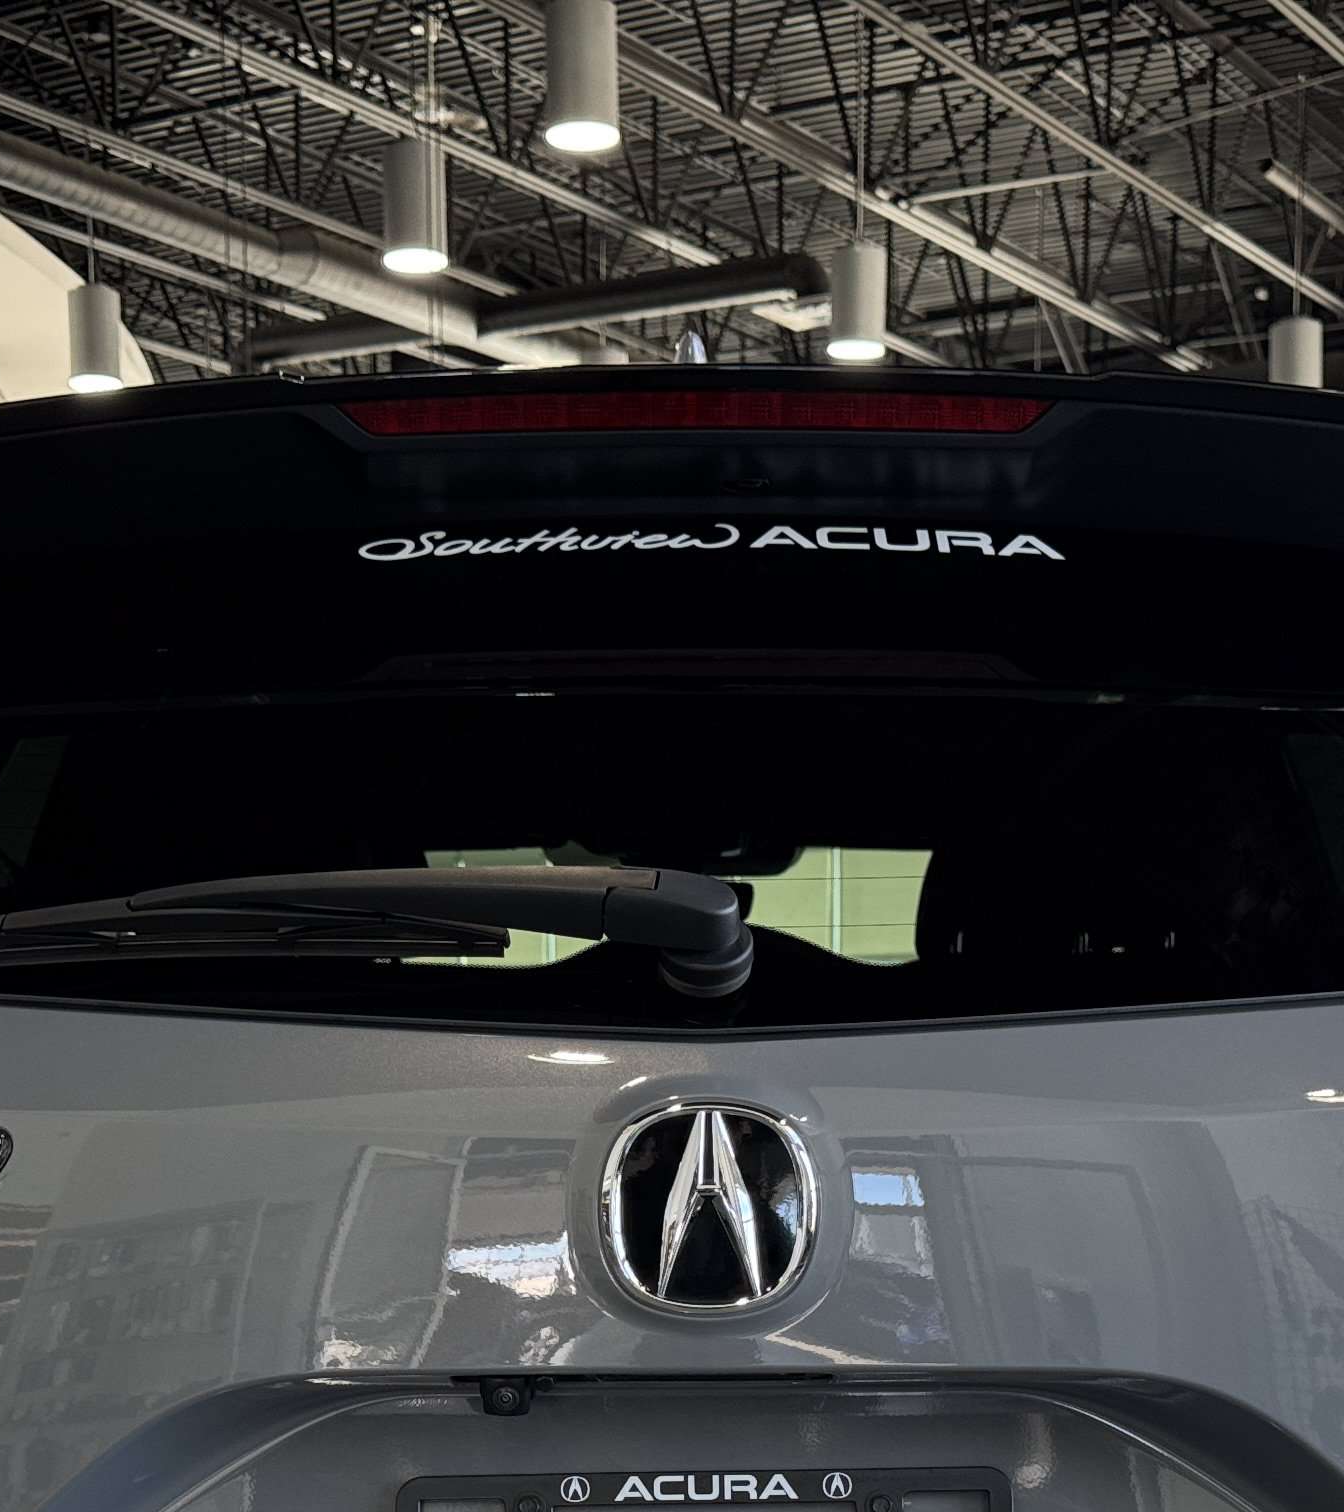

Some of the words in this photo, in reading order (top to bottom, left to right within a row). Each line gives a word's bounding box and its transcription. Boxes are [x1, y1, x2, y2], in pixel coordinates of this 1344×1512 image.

[358, 523, 740, 561] Southview
[750, 525, 1066, 560] ACURA
[614, 1473, 798, 1502] ACURA
